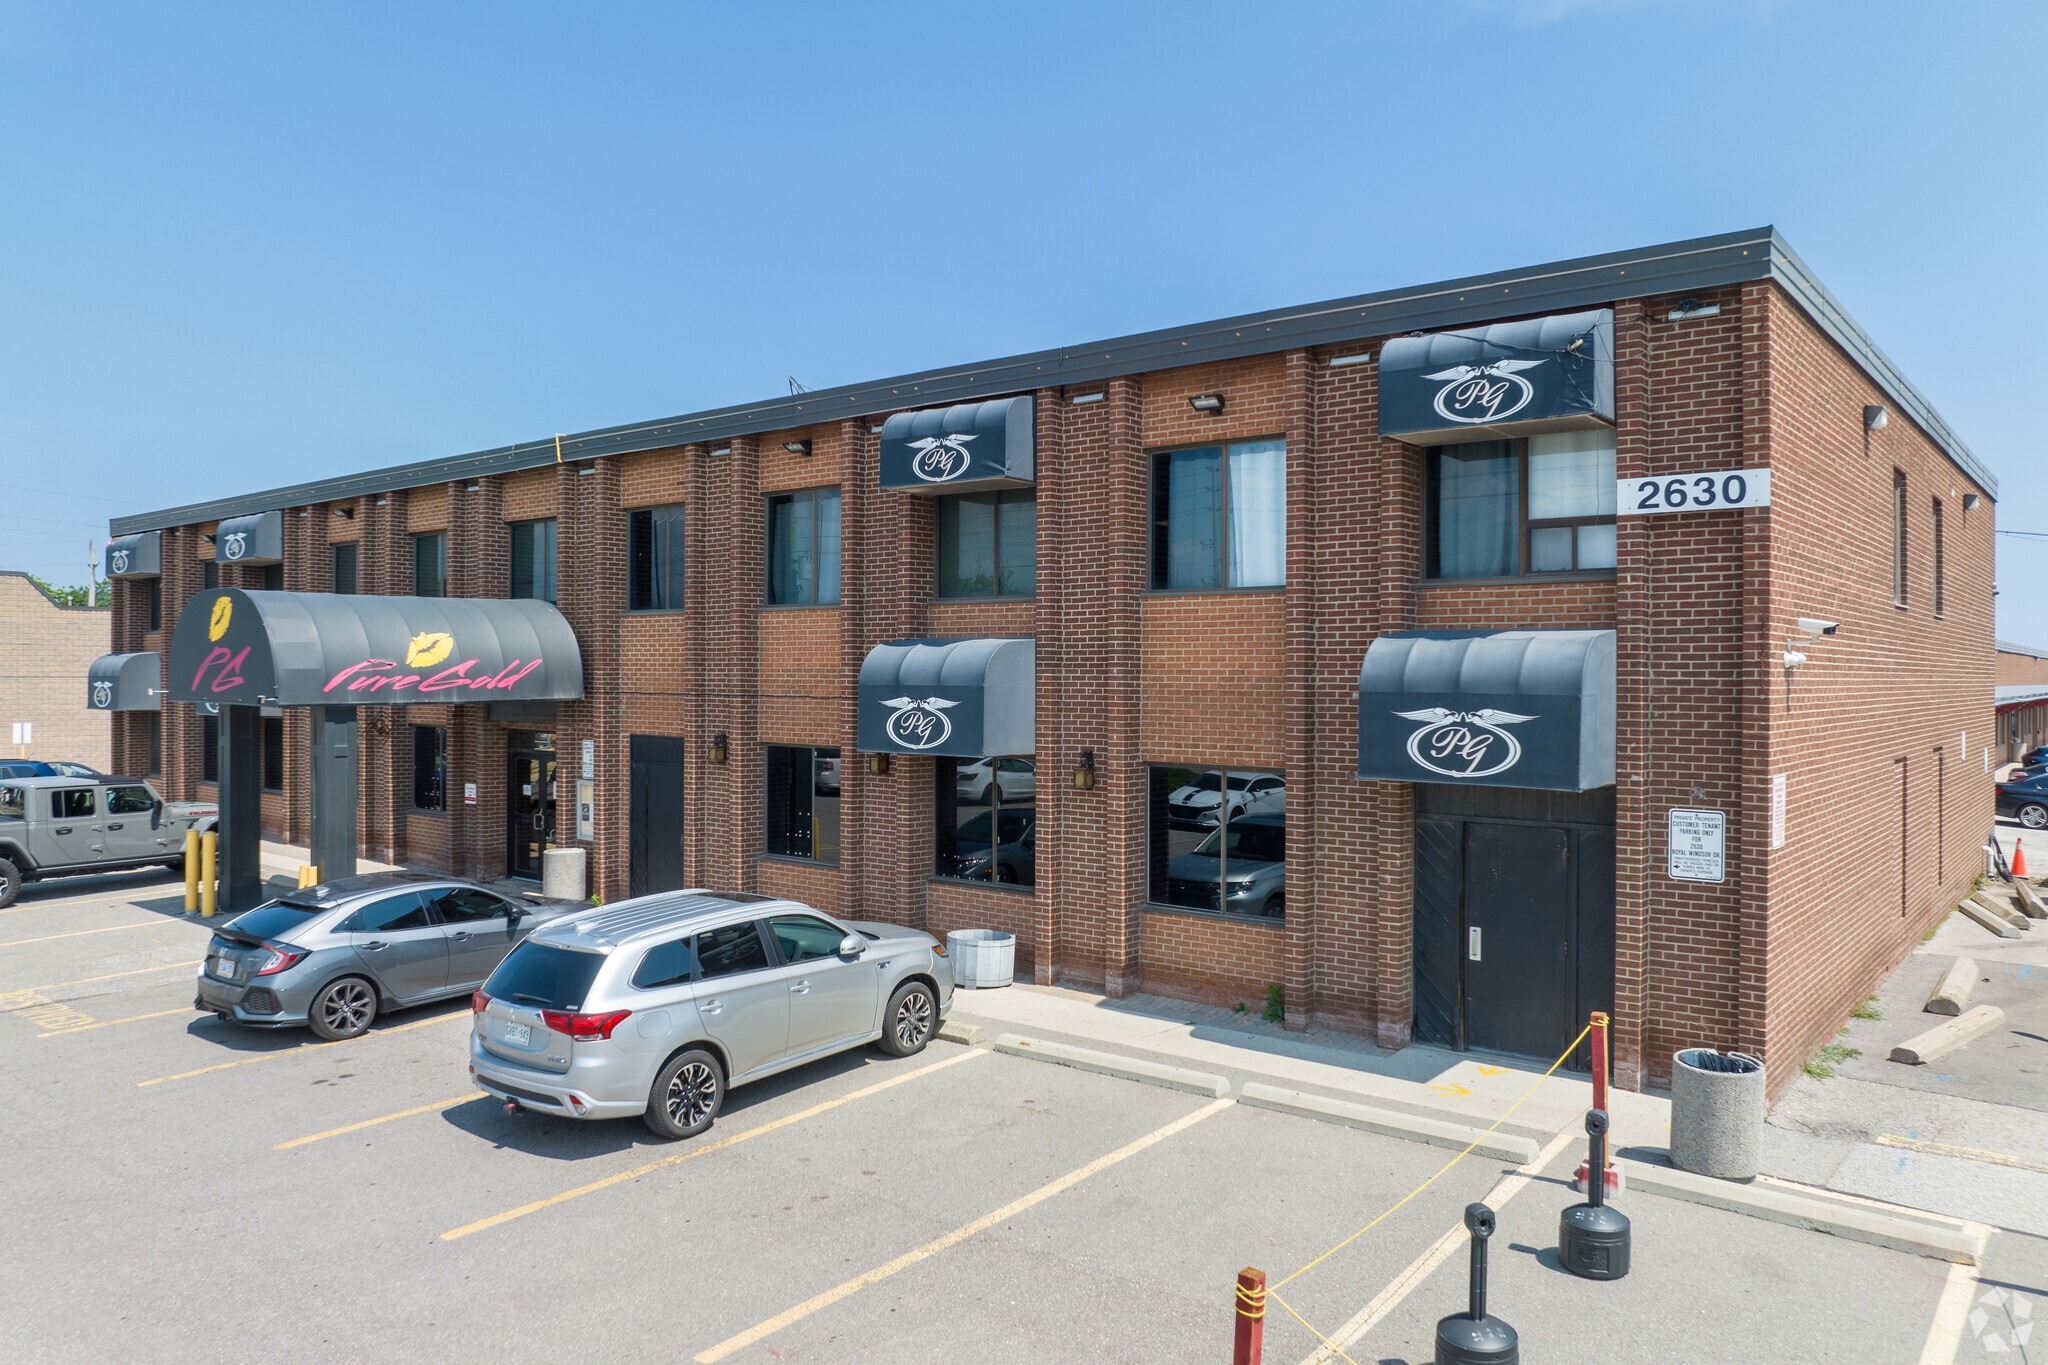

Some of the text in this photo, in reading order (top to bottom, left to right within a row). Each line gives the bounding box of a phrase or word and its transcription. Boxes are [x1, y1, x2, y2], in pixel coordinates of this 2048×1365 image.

[1454, 379, 1509, 418] PG
[925, 448, 957, 479] PG
[1637, 474, 1747, 510] 2630
[191, 645, 253, 693] PG
[322, 657, 544, 694] Pure Gold
[899, 711, 937, 746] PG
[1430, 726, 1494, 775] PG
